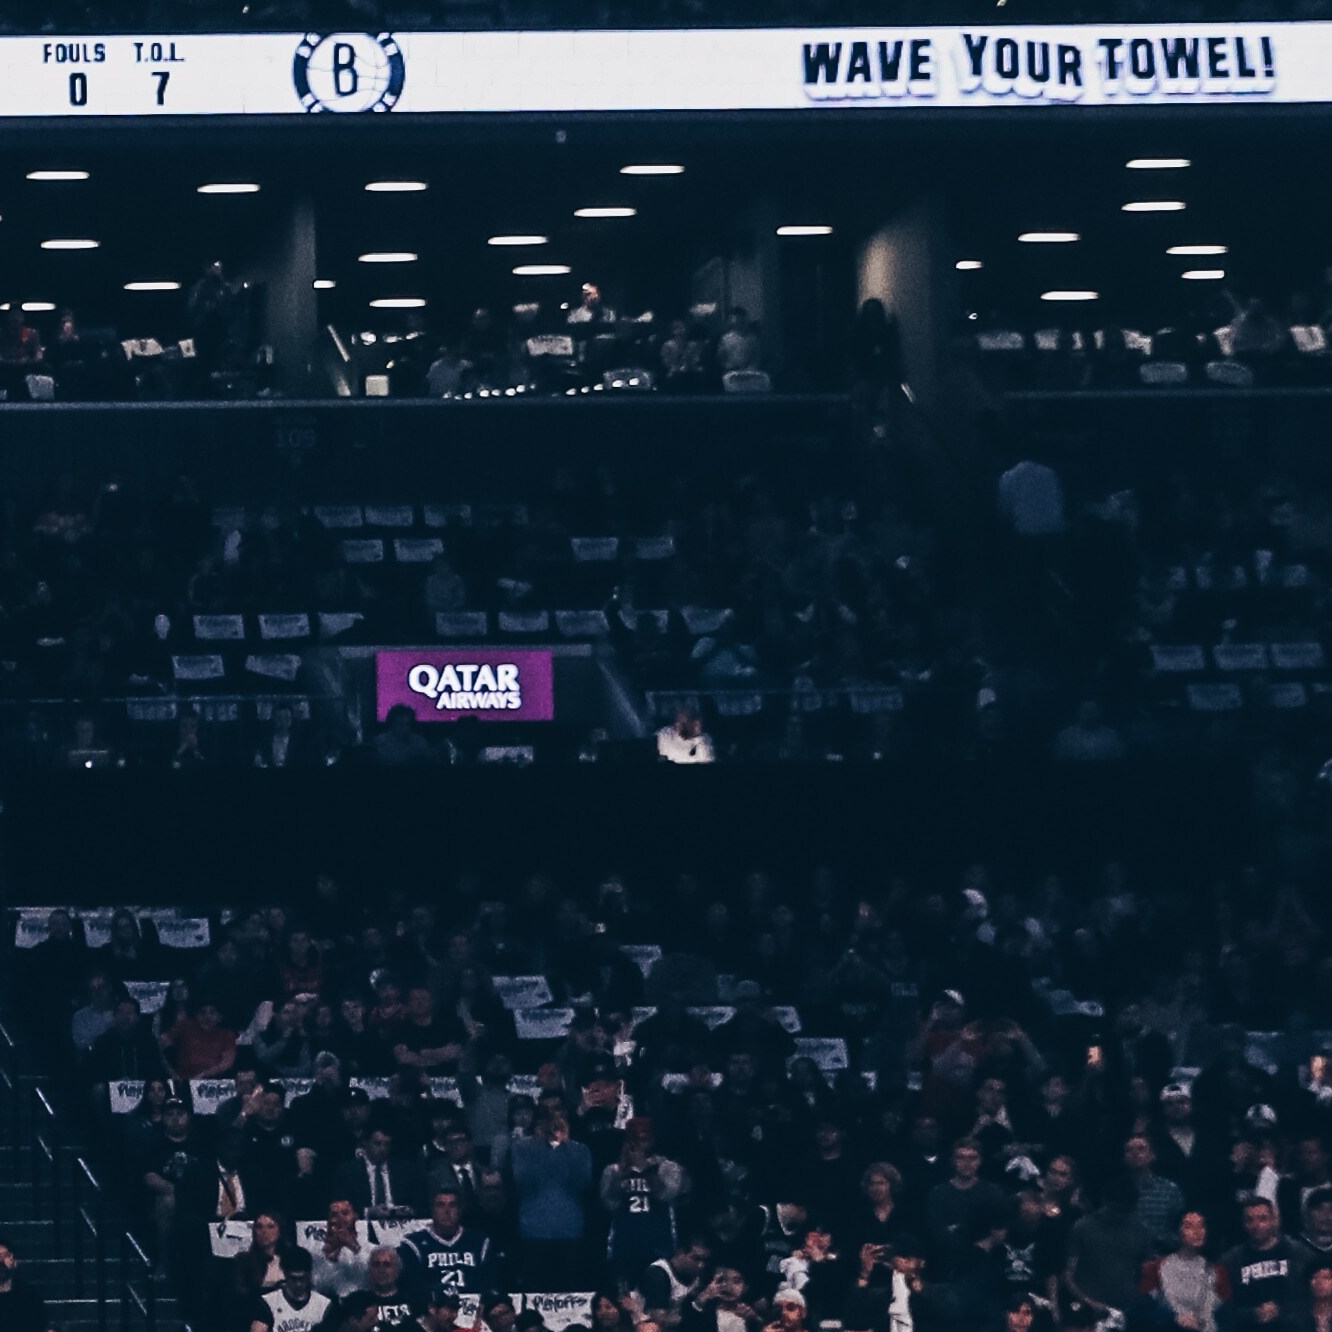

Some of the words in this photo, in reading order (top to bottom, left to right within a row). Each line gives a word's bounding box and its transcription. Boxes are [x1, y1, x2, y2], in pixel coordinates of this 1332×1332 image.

[43, 43, 106, 64] FOULS
[133, 43, 185, 64] T.O.L.
[803, 40, 930, 84] WAVE
[962, 34, 1083, 87] YOUR
[1098, 36, 1275, 80] TOWEL!
[69, 72, 87, 106] 0
[150, 71, 170, 106] 7
[408, 664, 520, 698] QATAR
[436, 690, 522, 710] AIRWAYS
[428, 1252, 475, 1268] PHILA
